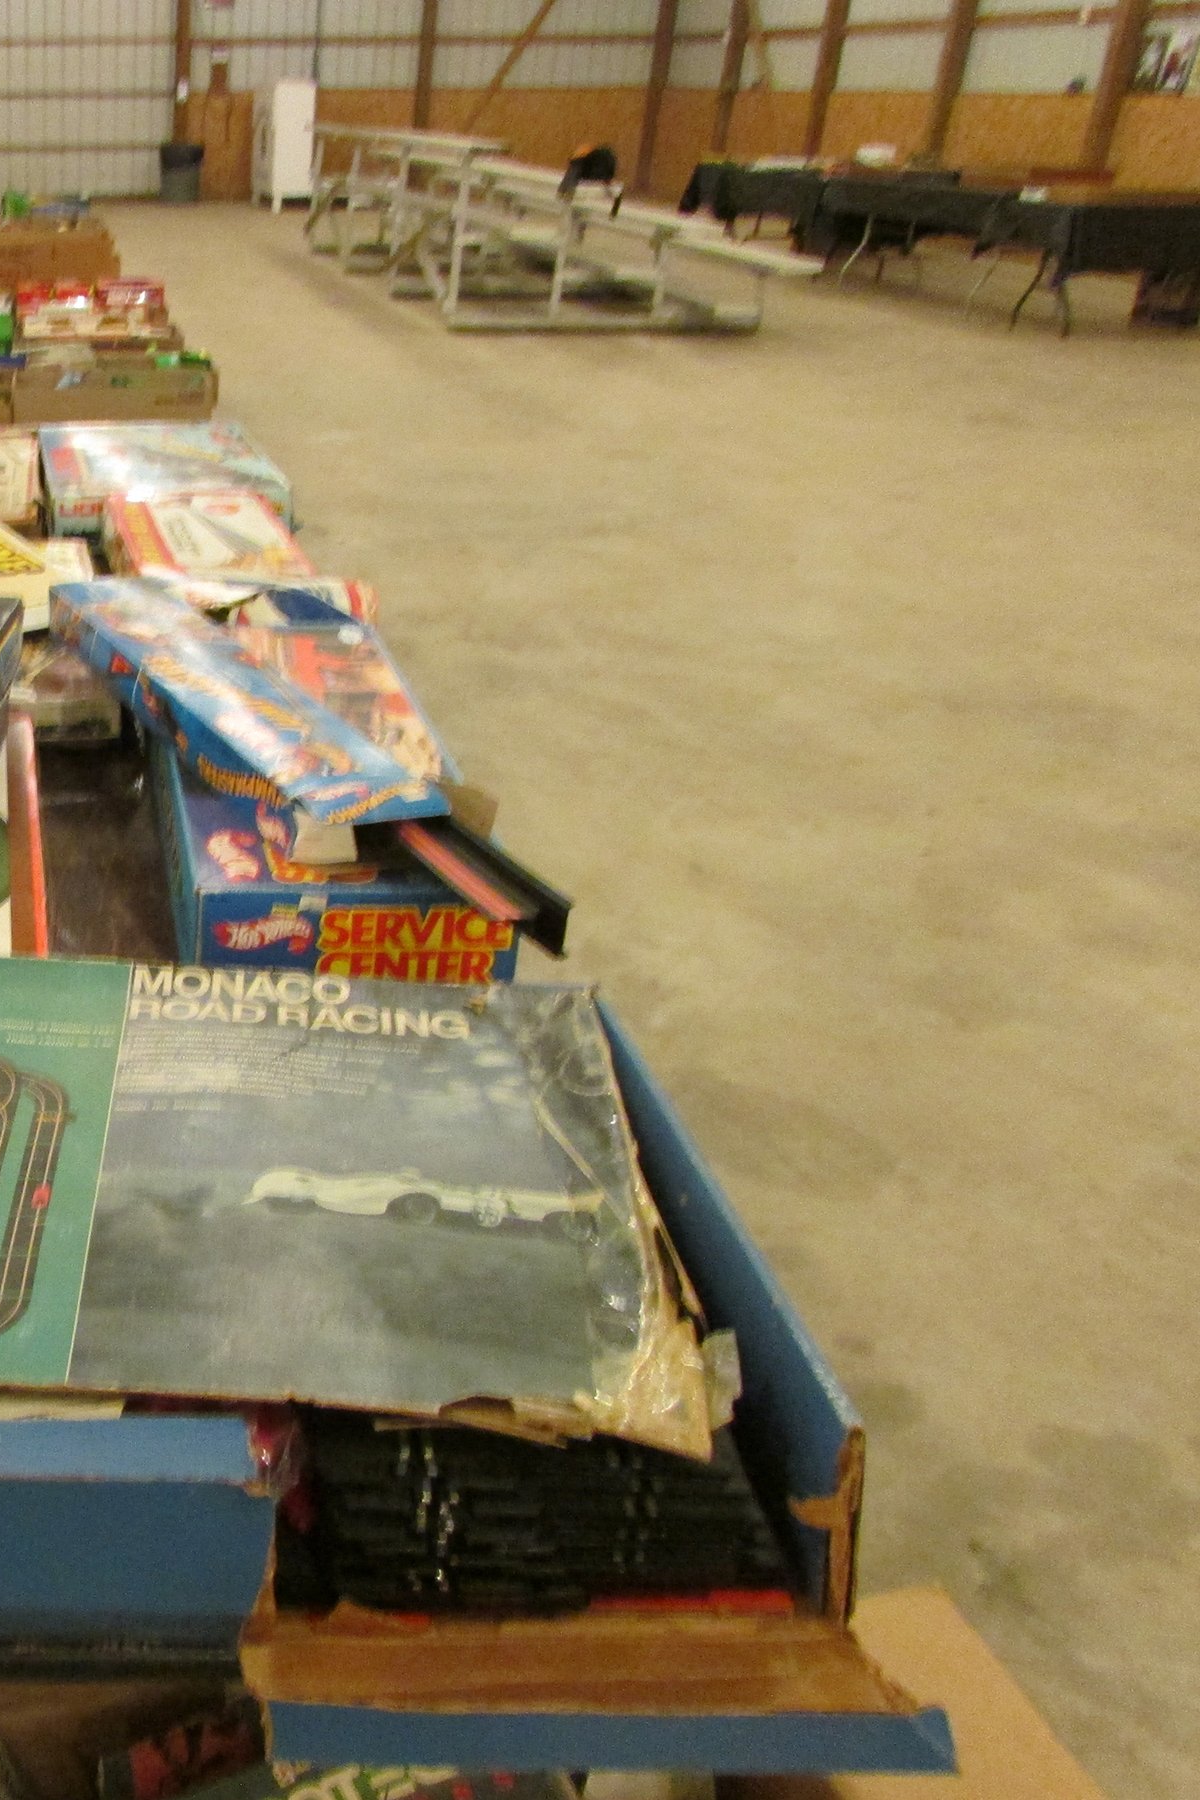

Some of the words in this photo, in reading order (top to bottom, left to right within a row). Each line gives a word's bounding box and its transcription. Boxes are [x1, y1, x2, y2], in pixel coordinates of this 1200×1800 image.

[318, 906, 514, 950] SERVICE
[132, 965, 349, 1005] MONACO
[316, 951, 494, 985] CENTER
[128, 1000, 266, 1023] ROAD
[277, 1004, 471, 1041] RACING
